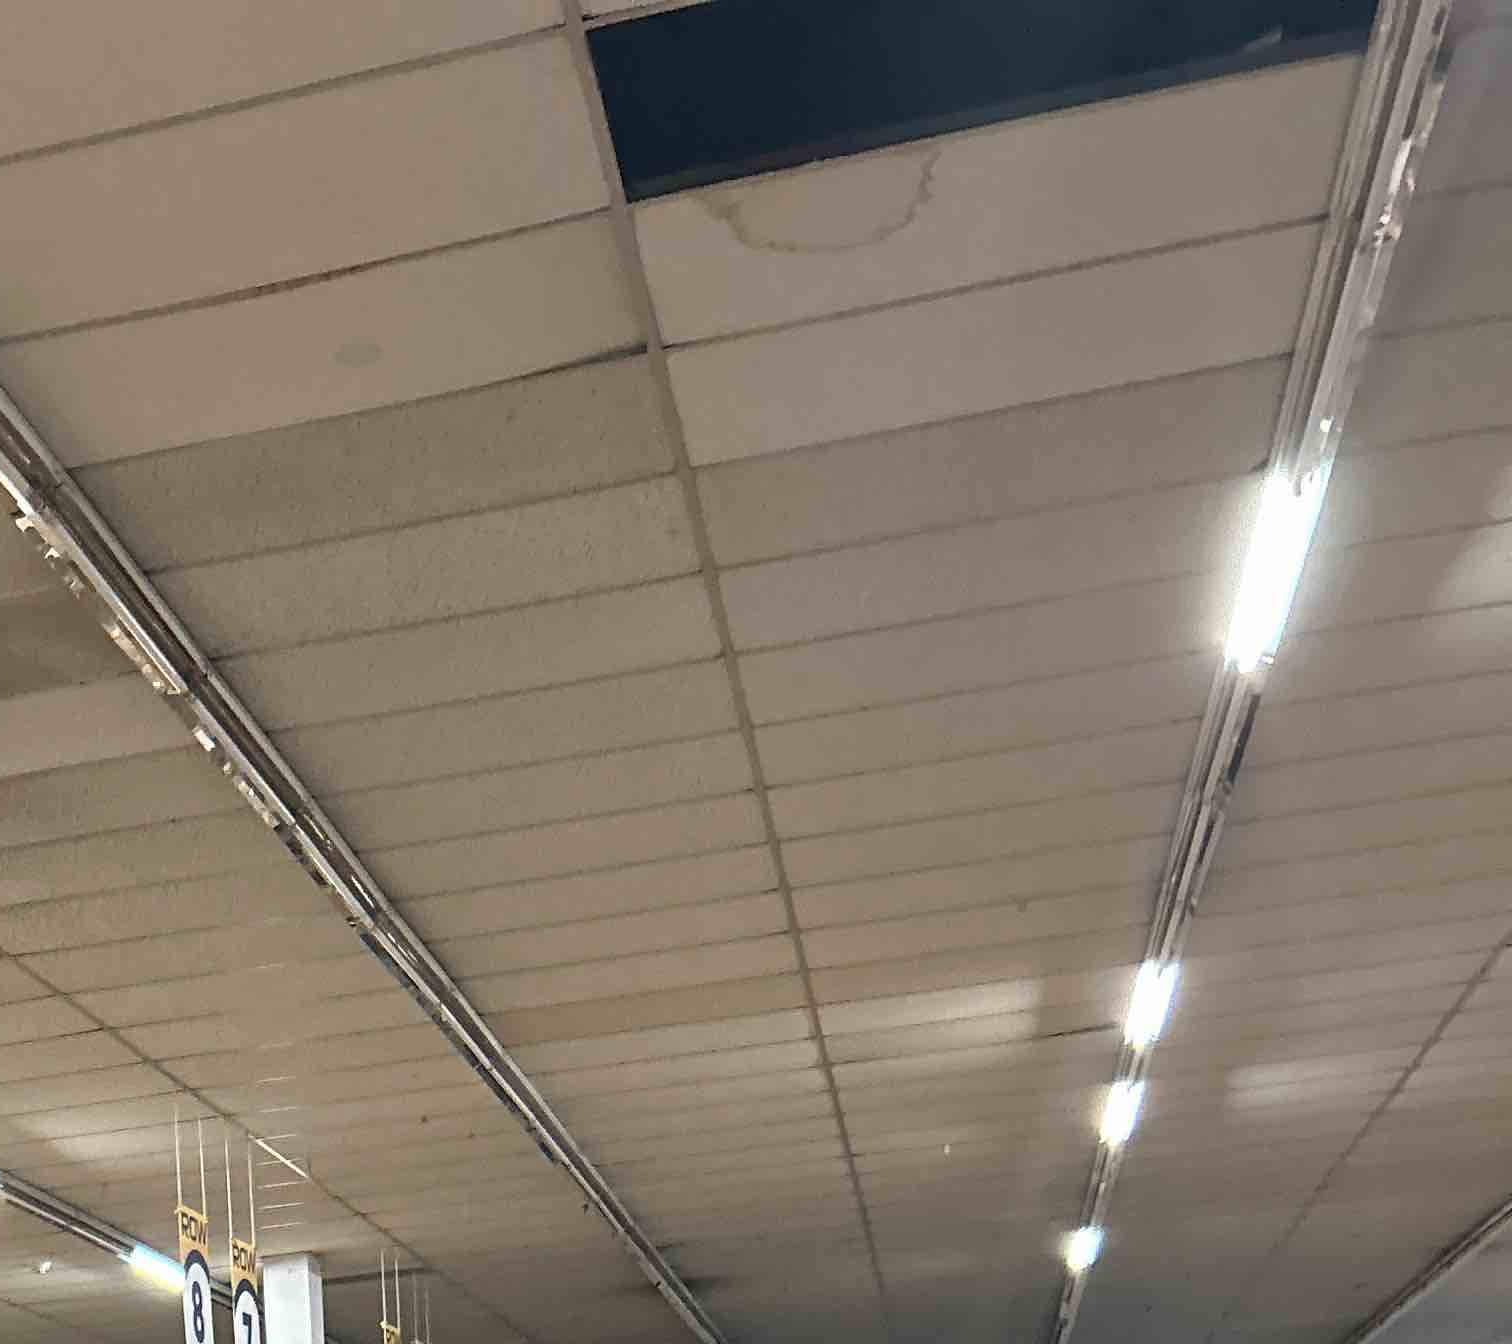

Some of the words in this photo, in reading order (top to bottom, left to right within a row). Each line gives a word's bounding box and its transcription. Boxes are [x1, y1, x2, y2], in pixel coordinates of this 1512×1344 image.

[181, 1213, 207, 1245] ROW
[233, 1243, 257, 1274] ROW
[191, 1280, 205, 1344] 8
